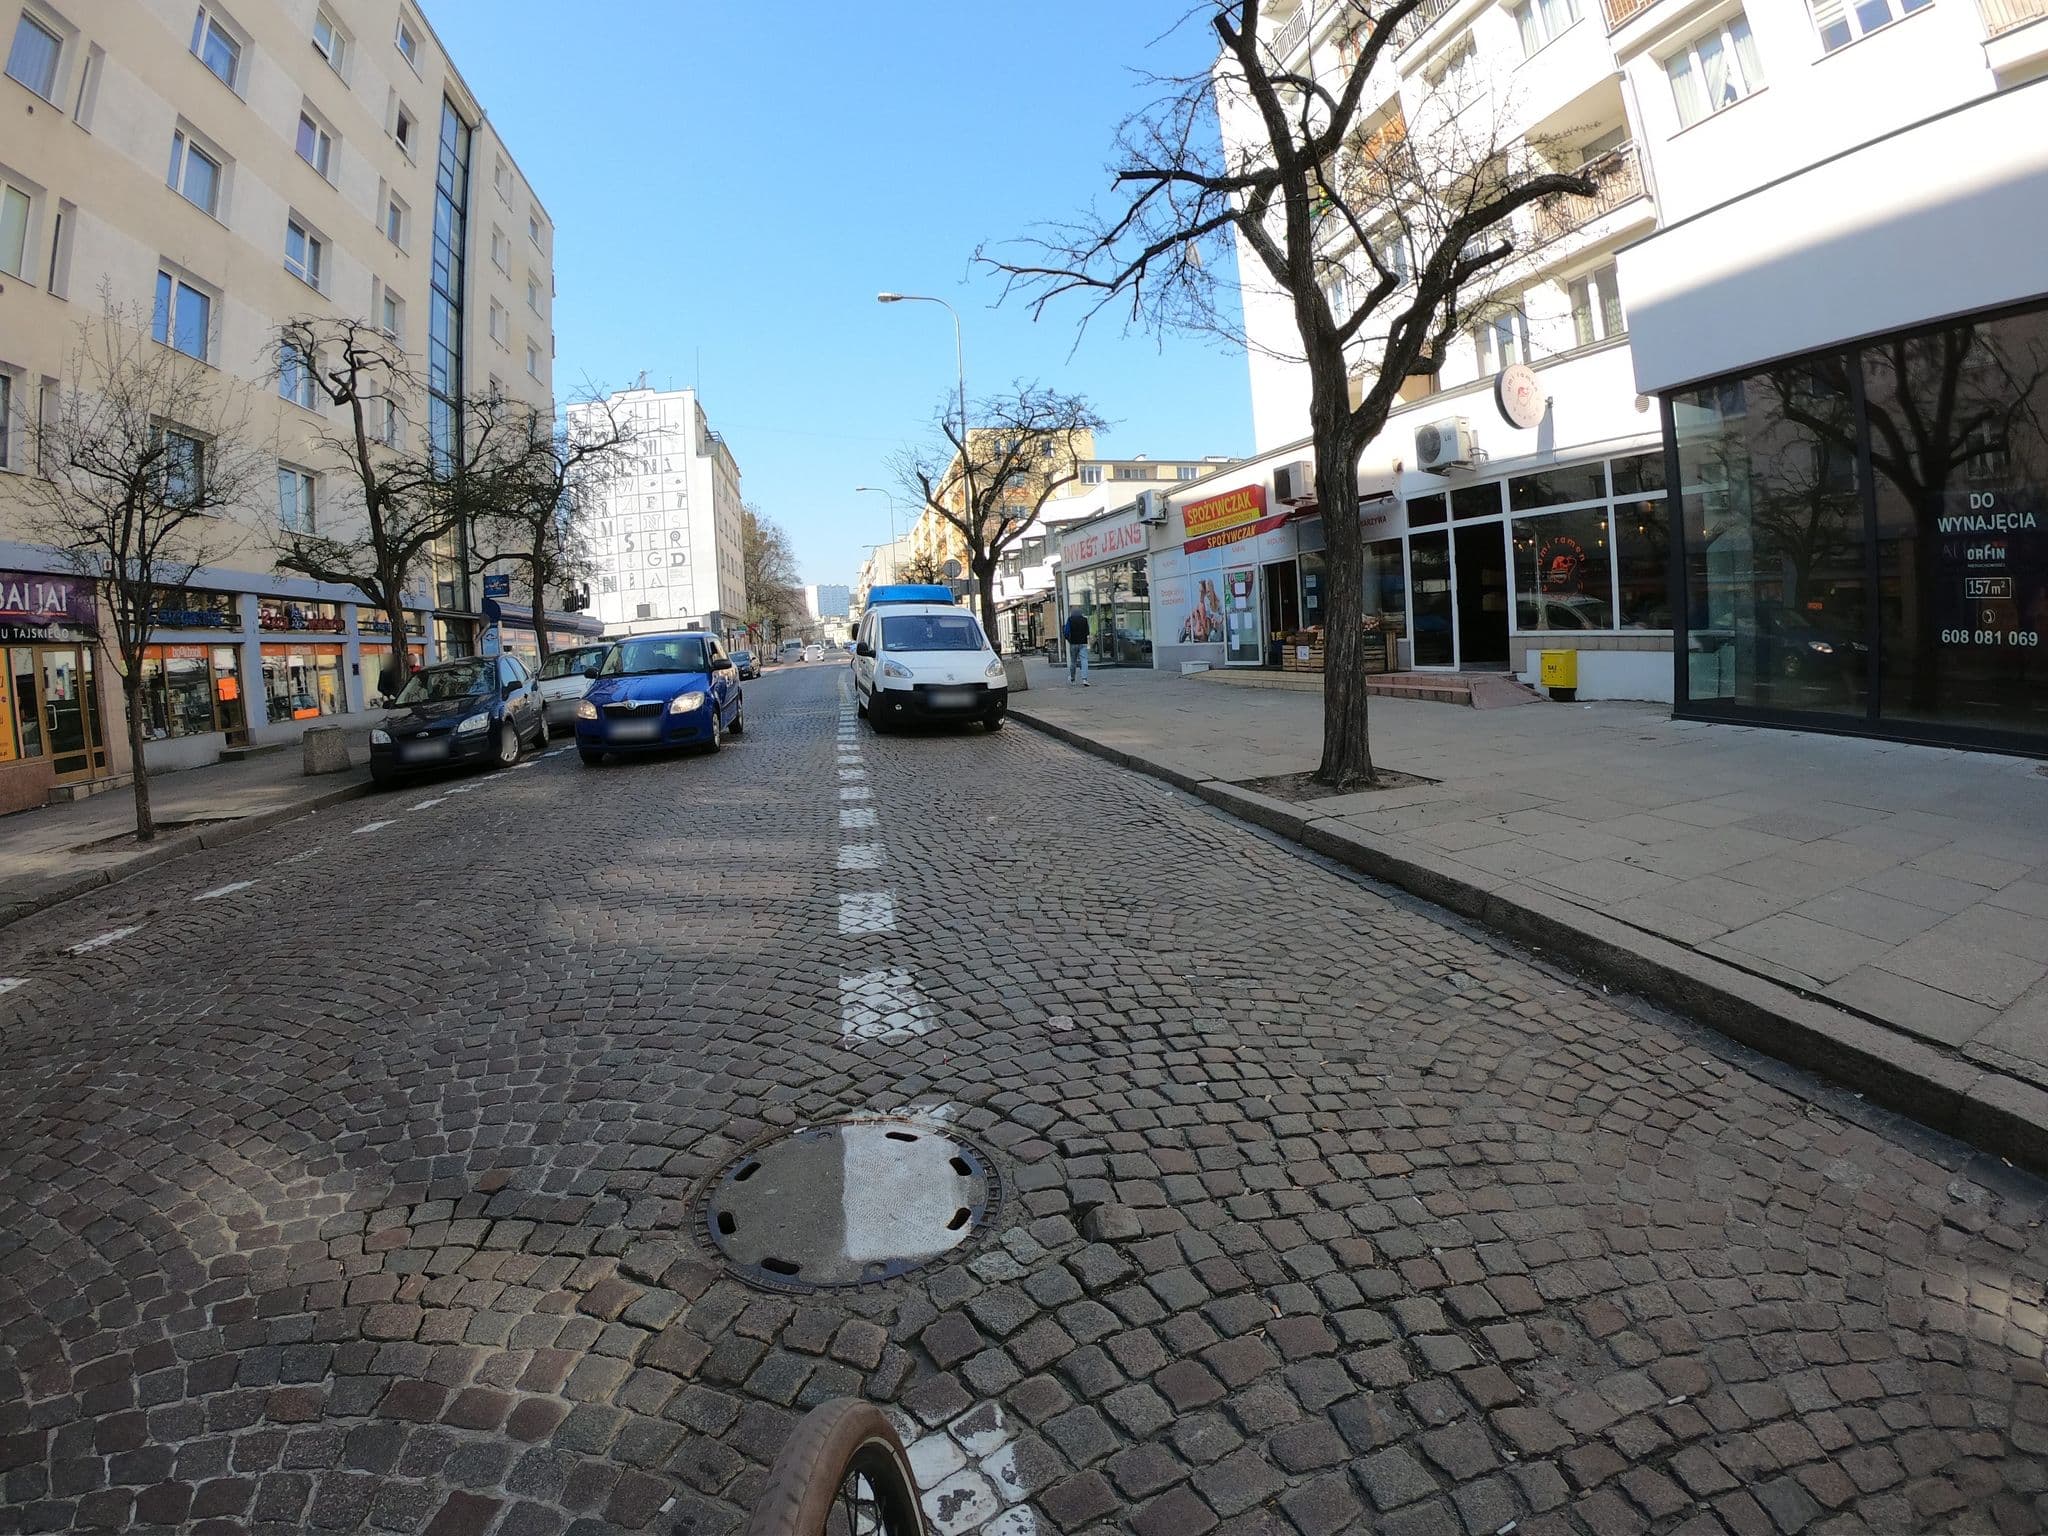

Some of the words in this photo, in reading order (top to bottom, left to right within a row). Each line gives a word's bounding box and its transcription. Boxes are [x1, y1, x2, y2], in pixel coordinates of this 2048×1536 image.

[1187, 491, 1252, 524] SPOŻYWCZAK
[1970, 492, 1995, 509] DO
[1937, 512, 2036, 533] WYNAJĘCIA
[1063, 536, 1099, 563] INVEST
[1102, 522, 1142, 553] JEANS
[1207, 525, 1257, 549] SPOŻYWCZAK
[1967, 544, 2006, 560] ORFIN
[36, 583, 67, 614] JAI
[13, 628, 69, 639] TAJSKIEGO
[1941, 629, 1970, 644] 608
[1974, 630, 2001, 645] 081
[2008, 631, 2039, 646] 069
